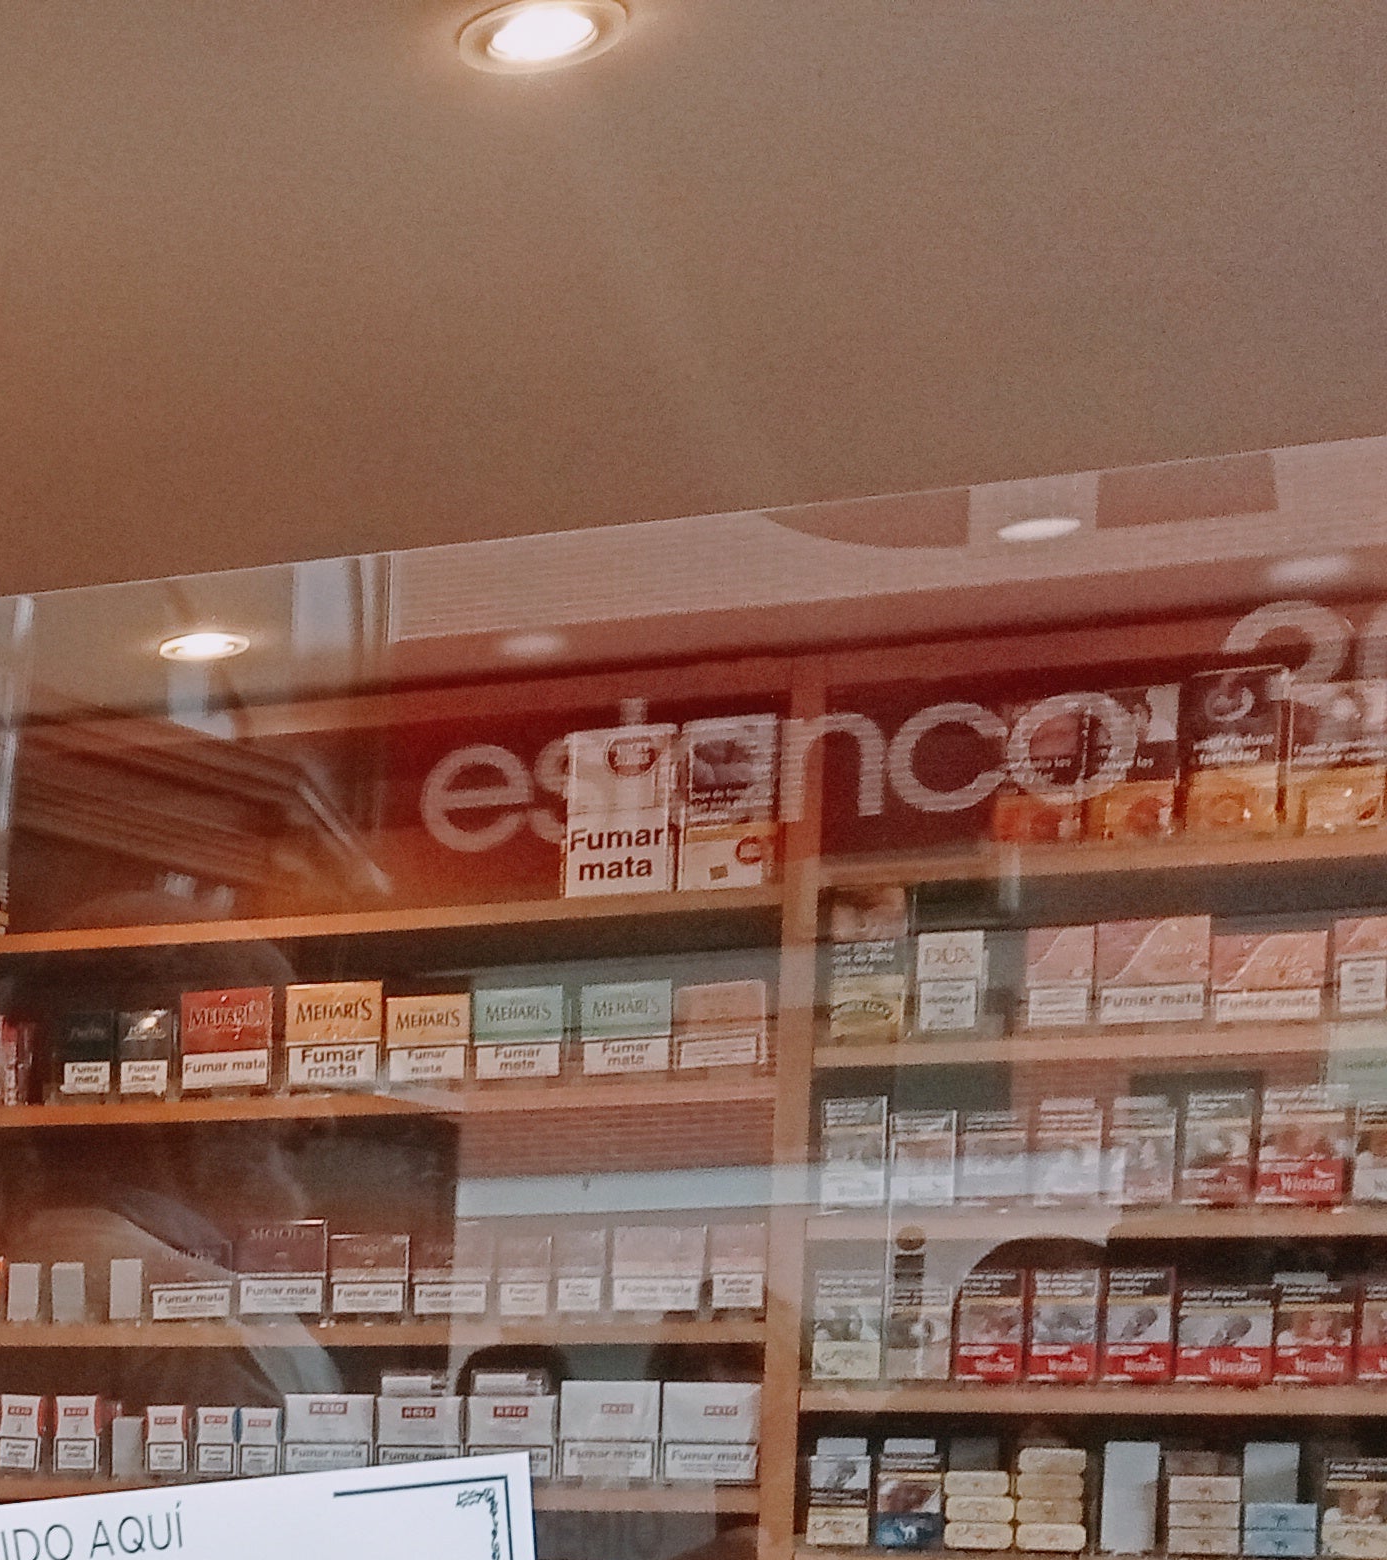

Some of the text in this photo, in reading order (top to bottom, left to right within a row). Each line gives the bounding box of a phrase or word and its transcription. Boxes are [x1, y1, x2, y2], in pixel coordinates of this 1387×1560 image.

[421, 690, 1137, 853] esnco
[570, 828, 665, 852] Fumar
[579, 856, 653, 881] mata
[494, 1046, 540, 1059] Fumar
[602, 1041, 651, 1055] Fumar
[300, 1048, 364, 1064] Fumar
[184, 1059, 266, 1074] Fumar mata
[307, 1065, 357, 1079] mata
[246, 1285, 317, 1296] Fumar mata
[311, 1403, 345, 1414] REIG
[404, 1407, 434, 1417] REIG
[495, 1407, 526, 1417] REIG
[90, 1500, 184, 1559] AQUÍ
